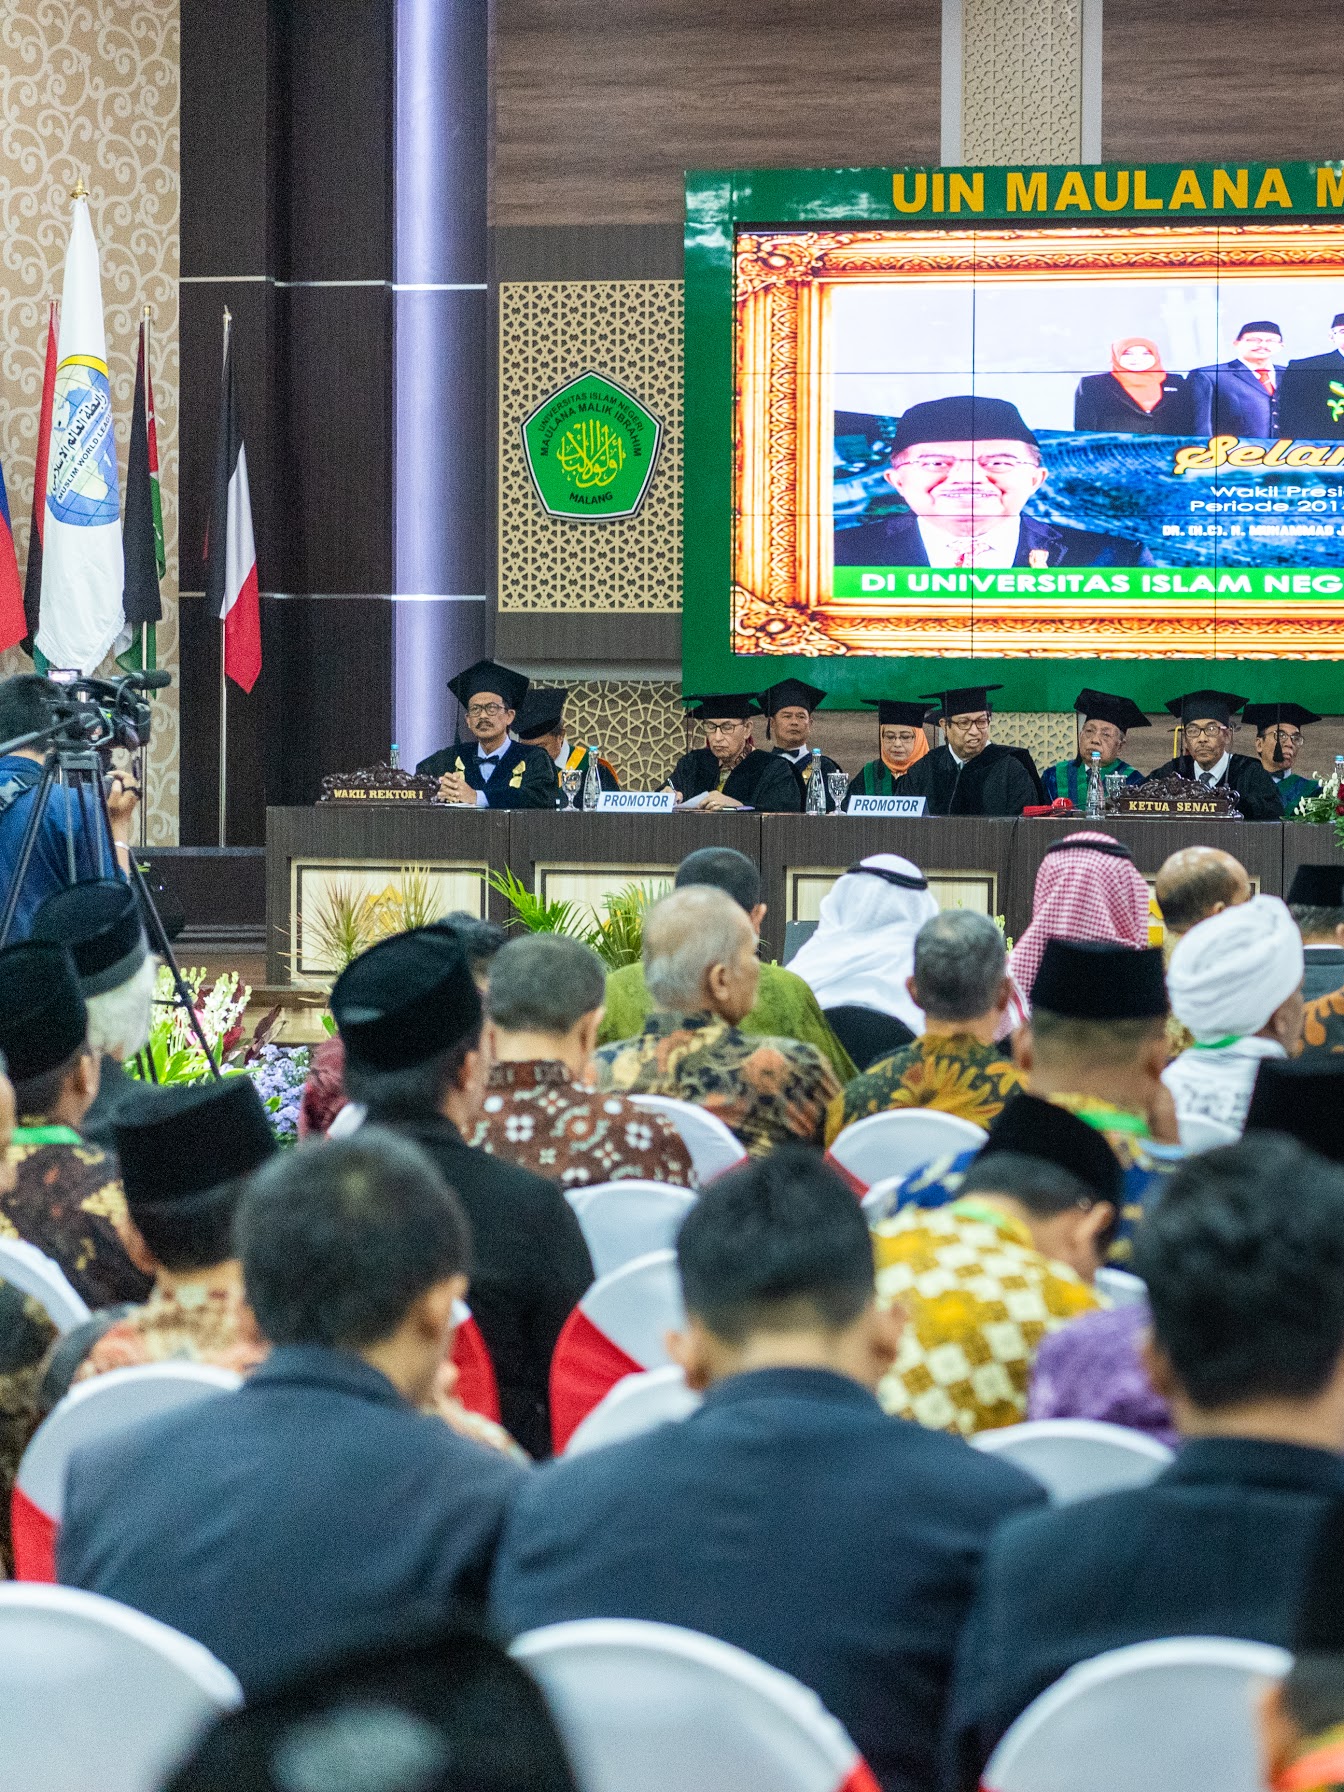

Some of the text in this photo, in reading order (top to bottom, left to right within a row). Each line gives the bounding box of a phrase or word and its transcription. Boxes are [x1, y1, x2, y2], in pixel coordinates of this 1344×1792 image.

[892, 172, 984, 213] UIN
[1006, 168, 1293, 212] MAULANA
[538, 392, 644, 432] UNIVERSITAS ISLAM NEGERI
[541, 403, 642, 457] MAULANA MALIK IBRAHIM
[59, 468, 80, 500] MUSLIM
[77, 438, 99, 466] WORLD
[569, 491, 613, 504] MALANG
[1210, 486, 1278, 498] Wakil
[1190, 500, 1289, 513] Periode
[1249, 525, 1334, 536] MUHAMMAD
[861, 574, 896, 592] DI
[908, 574, 1130, 593] UNIVERSITAS
[1142, 575, 1252, 593] ISLAM
[333, 789, 423, 799] WAKIL REKTOR I
[603, 794, 669, 807] PROMOTOR
[854, 799, 918, 812] PROMOTOR
[1128, 801, 1217, 812] KETUA SENAT
